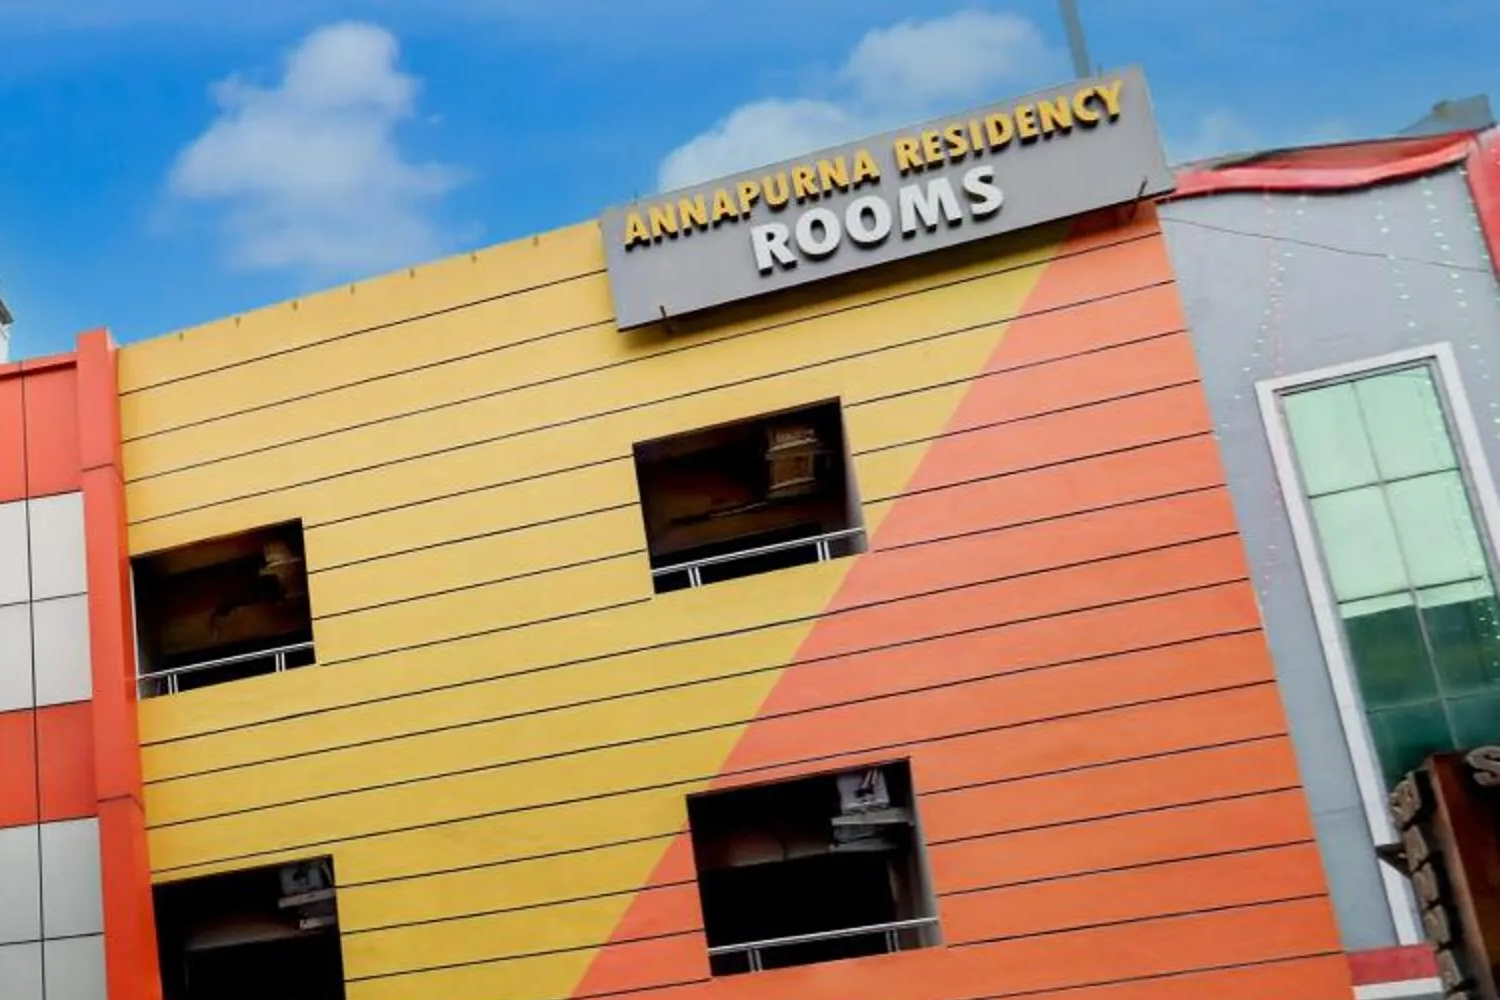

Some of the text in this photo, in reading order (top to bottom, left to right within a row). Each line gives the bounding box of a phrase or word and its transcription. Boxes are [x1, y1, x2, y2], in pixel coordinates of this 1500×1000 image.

[623, 80, 1123, 250] ANNAPURNA RESIDENCY
[751, 165, 1003, 276] ROOMS
